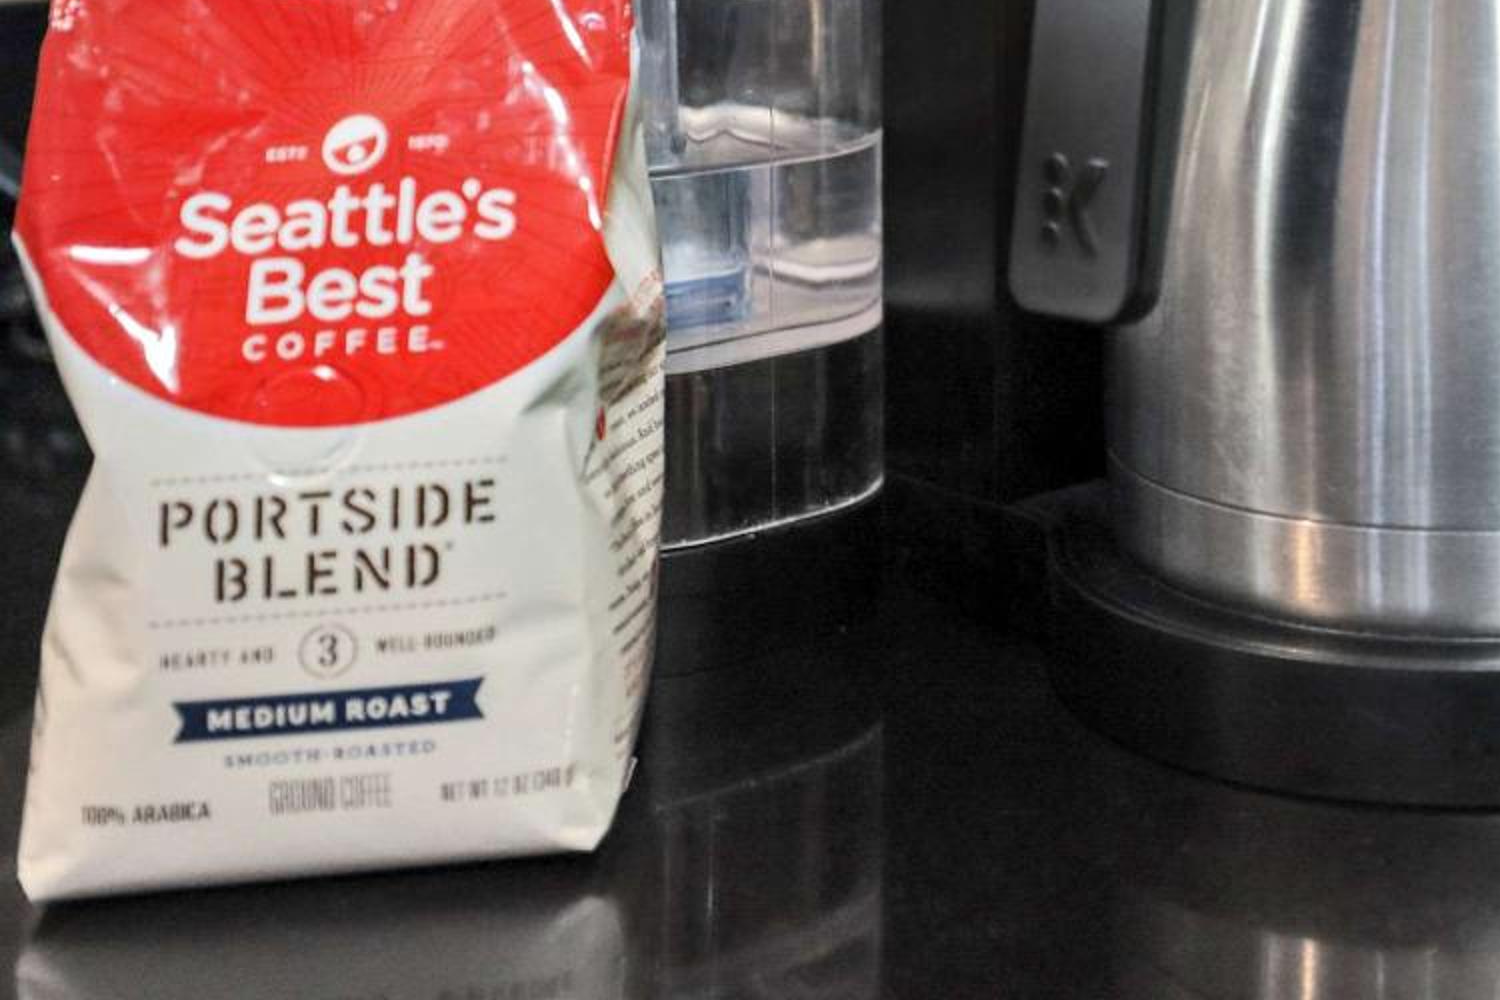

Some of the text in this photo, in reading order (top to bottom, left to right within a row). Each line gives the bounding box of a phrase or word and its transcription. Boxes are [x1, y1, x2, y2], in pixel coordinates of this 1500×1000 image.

[174, 176, 517, 259] Seattle's
[245, 253, 435, 326] Best
[241, 325, 431, 362] COFFEE
[159, 478, 496, 548] PORTSIDE
[215, 543, 441, 603] BLEND
[317, 633, 339, 667] 3
[206, 690, 451, 733] MEDIUM ROAST
[132, 801, 212, 825] ARABICA
